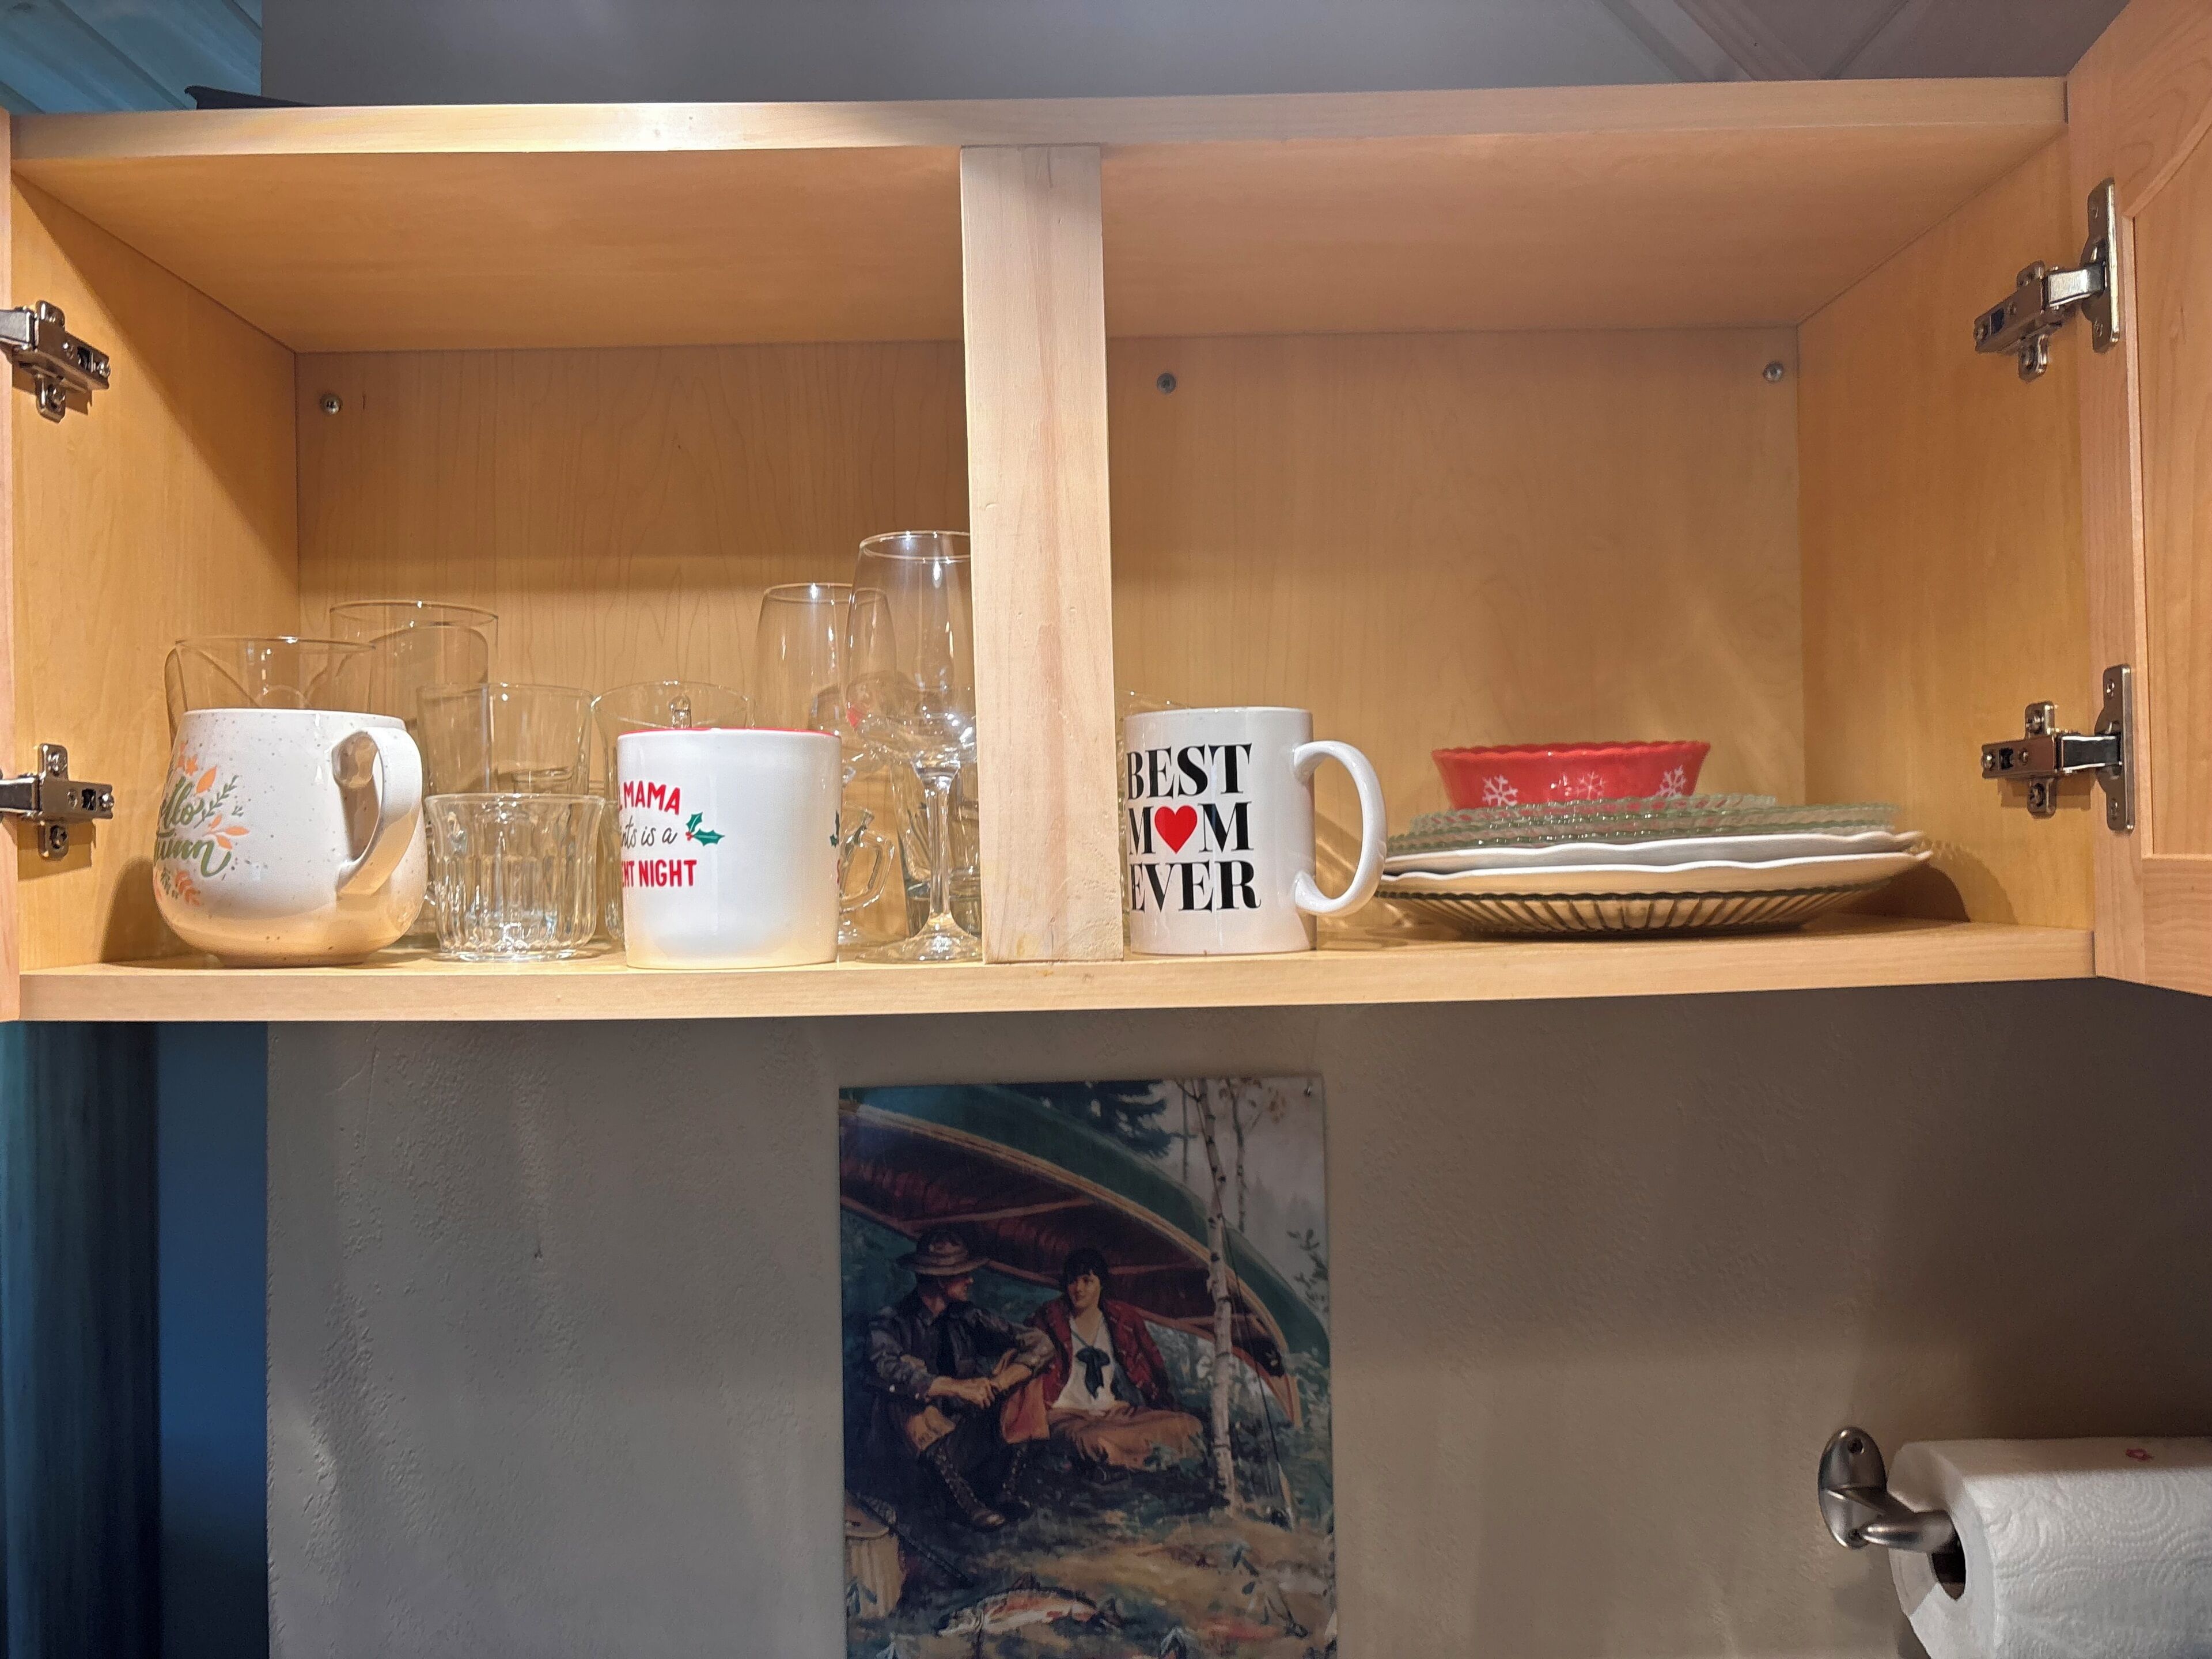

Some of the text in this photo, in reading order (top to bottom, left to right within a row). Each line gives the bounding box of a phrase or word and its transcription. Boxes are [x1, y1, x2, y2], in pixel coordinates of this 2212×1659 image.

[1126, 743, 1252, 801] BEST
[158, 775, 204, 830] ello
[623, 780, 680, 816] MAMA
[641, 825, 657, 847] is
[661, 827, 678, 844] a
[638, 859, 697, 888] NIGHT
[1130, 859, 1262, 914] EVER
